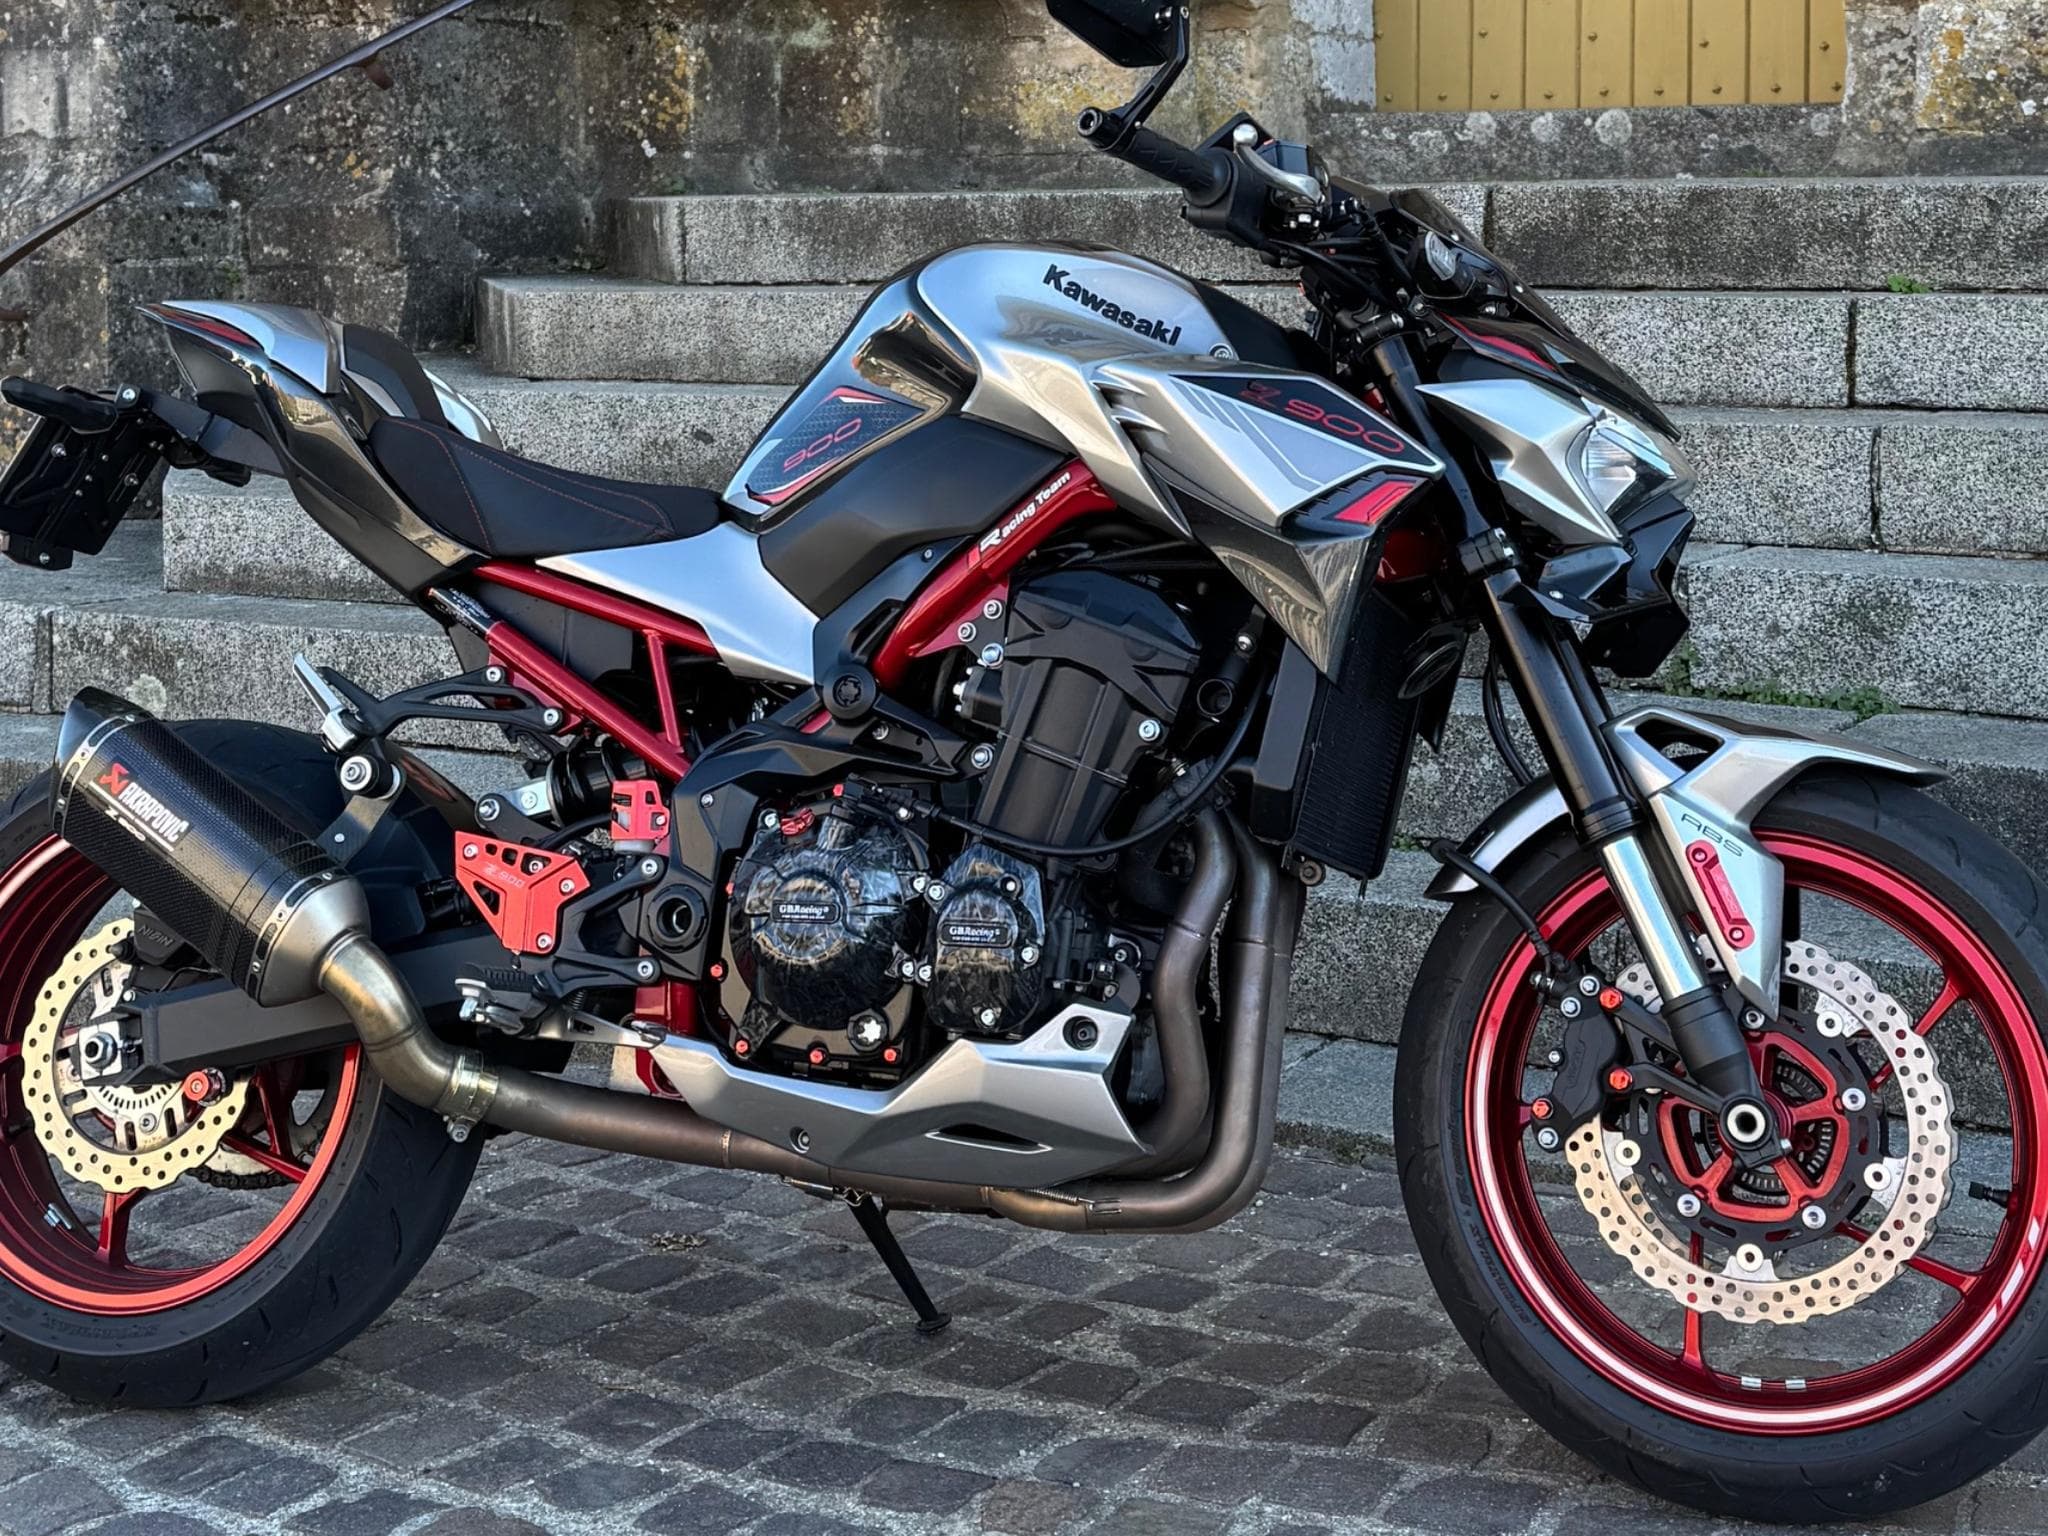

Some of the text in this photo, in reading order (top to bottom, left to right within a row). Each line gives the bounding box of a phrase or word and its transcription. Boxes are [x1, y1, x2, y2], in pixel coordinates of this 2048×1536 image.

[1042, 263, 1183, 347] Kawasaki
[783, 417, 862, 474] 900
[1284, 398, 1405, 453] 900
[980, 471, 1071, 552] Racing Team
[1681, 812, 1745, 858] ABS
